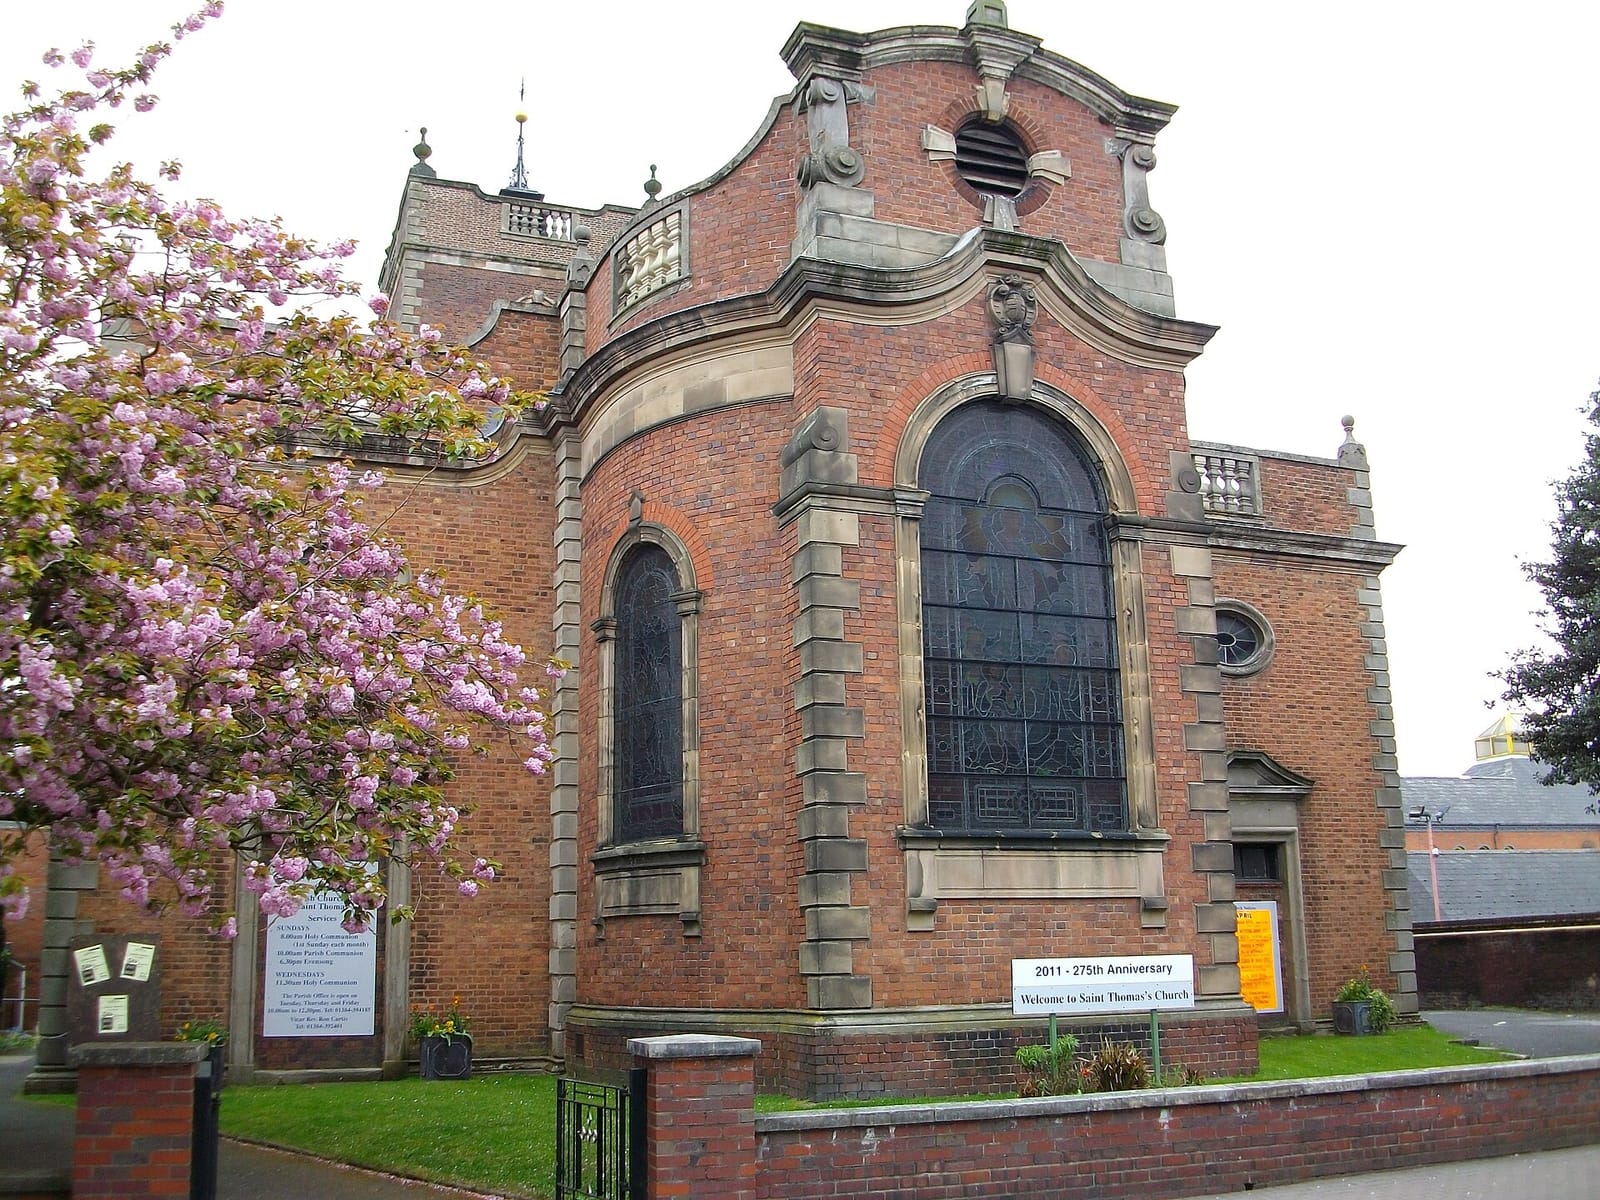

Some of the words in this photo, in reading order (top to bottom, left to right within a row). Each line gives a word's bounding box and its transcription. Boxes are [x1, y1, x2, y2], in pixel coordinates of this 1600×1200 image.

[1035, 966, 1061, 976] 2011
[1073, 965, 1104, 976] 275th
[1107, 963, 1173, 975] Anniversary
[1021, 994, 1064, 1004] Welcome
[1067, 994, 1077, 1003] to
[1079, 993, 1104, 1003] Saint
[1108, 991, 1152, 1002] Thomas's
[1154, 990, 1188, 1000] Church
